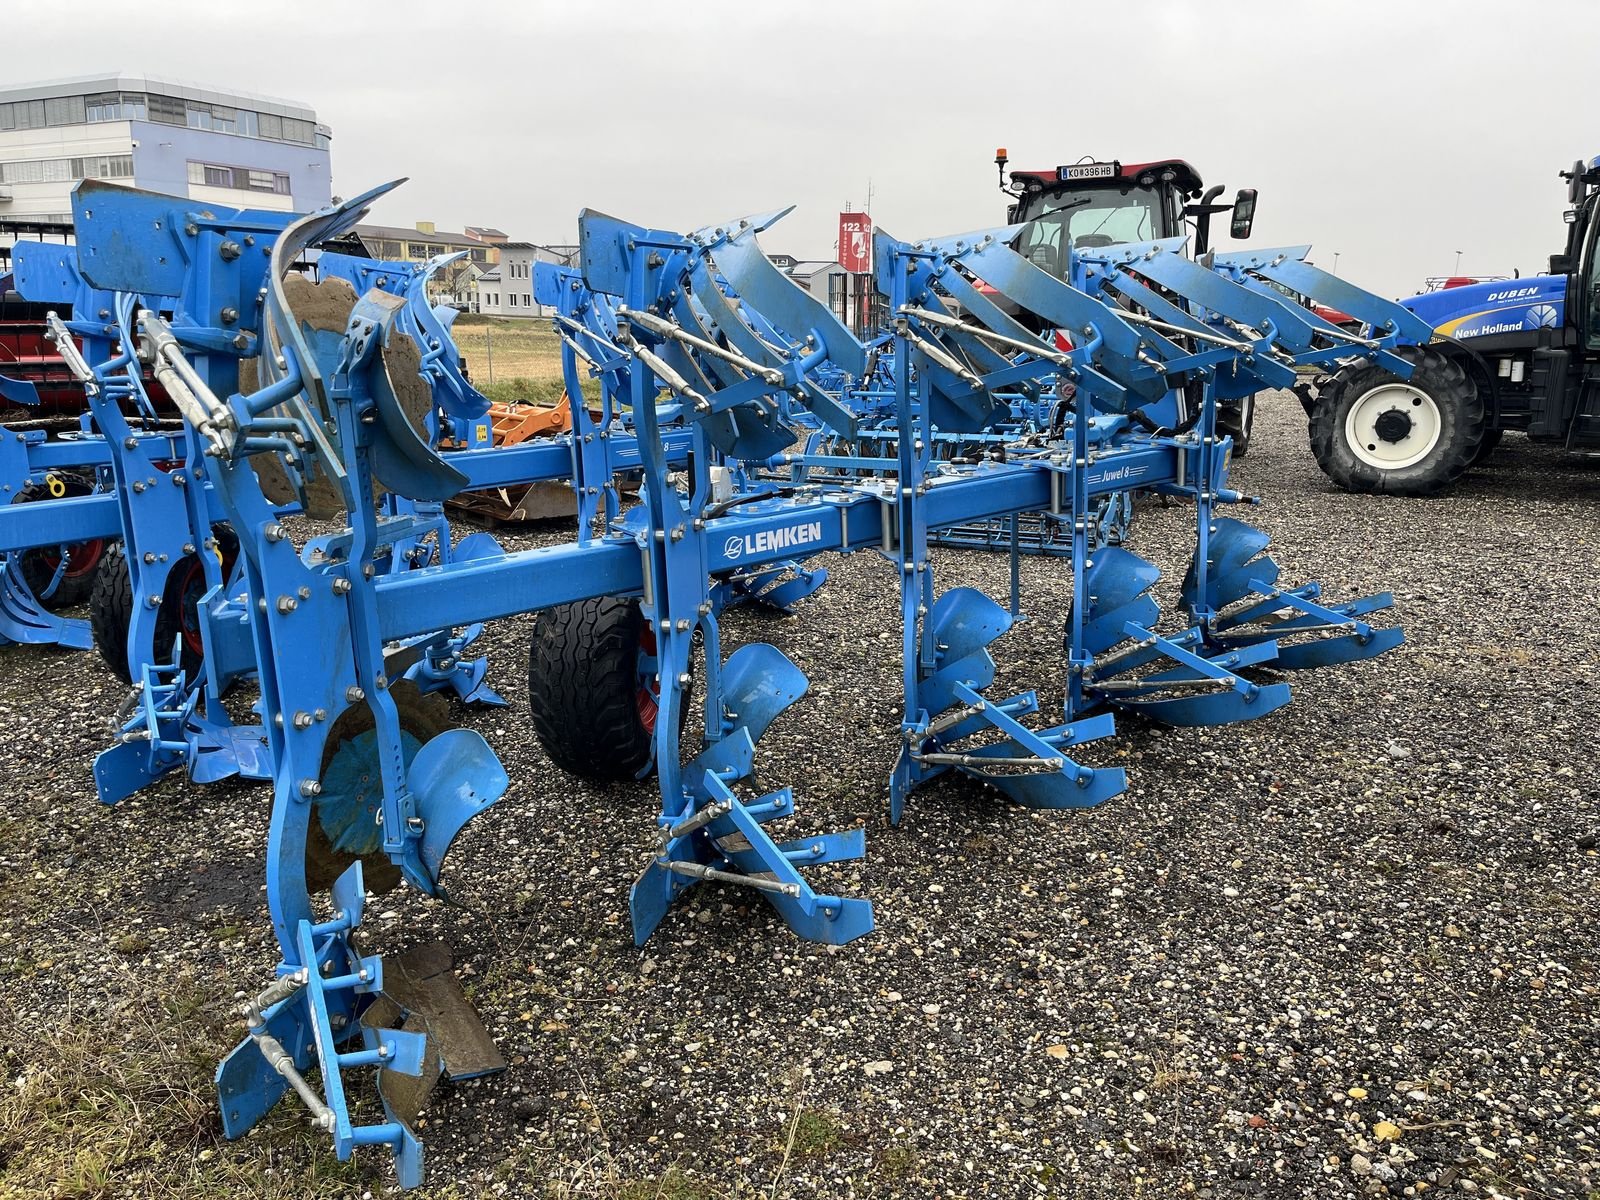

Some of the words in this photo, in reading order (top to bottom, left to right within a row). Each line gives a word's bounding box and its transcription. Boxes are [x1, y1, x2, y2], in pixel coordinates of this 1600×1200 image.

[1084, 168, 1100, 177] 396
[842, 222, 860, 232] 122
[1487, 286, 1538, 302] DUBEN
[1455, 328, 1479, 339] New
[1481, 321, 1523, 335] Holland
[1102, 466, 1124, 482] Juwel
[1123, 466, 1130, 478] 8
[745, 521, 821, 554] LEMKEN
